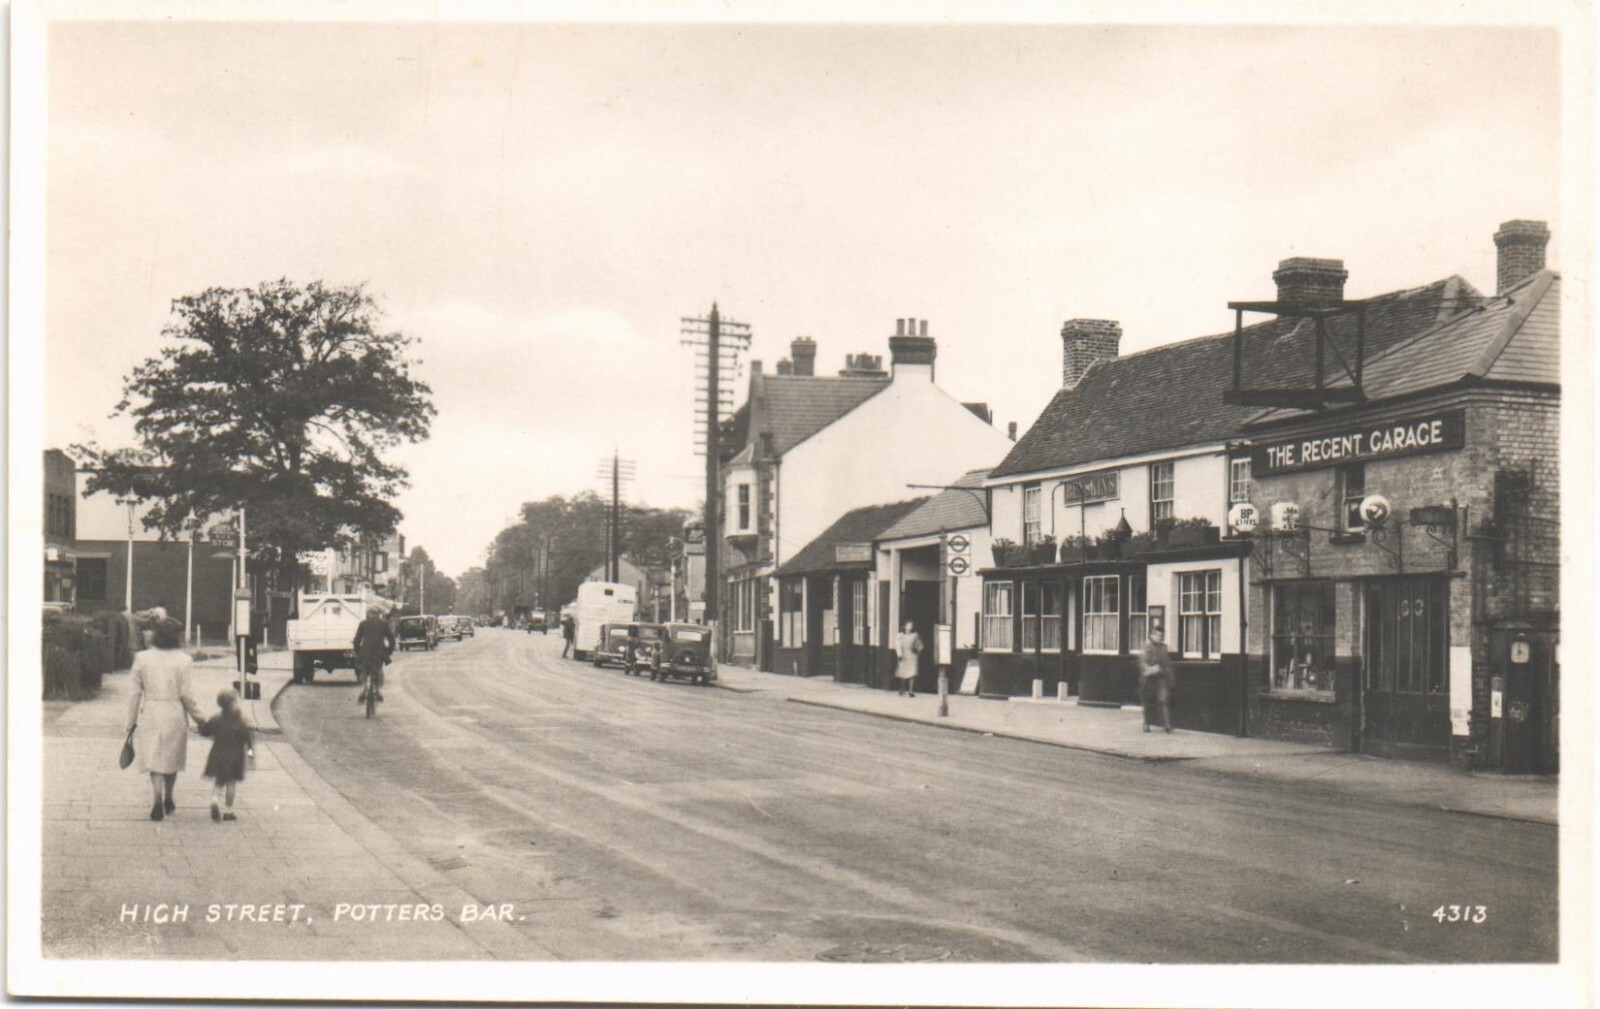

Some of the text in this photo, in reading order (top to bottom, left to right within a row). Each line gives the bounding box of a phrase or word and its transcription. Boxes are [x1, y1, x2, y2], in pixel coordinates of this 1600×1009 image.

[1266, 420, 1443, 468] THE REGENT GARAGE
[1240, 508, 1254, 519] BP
